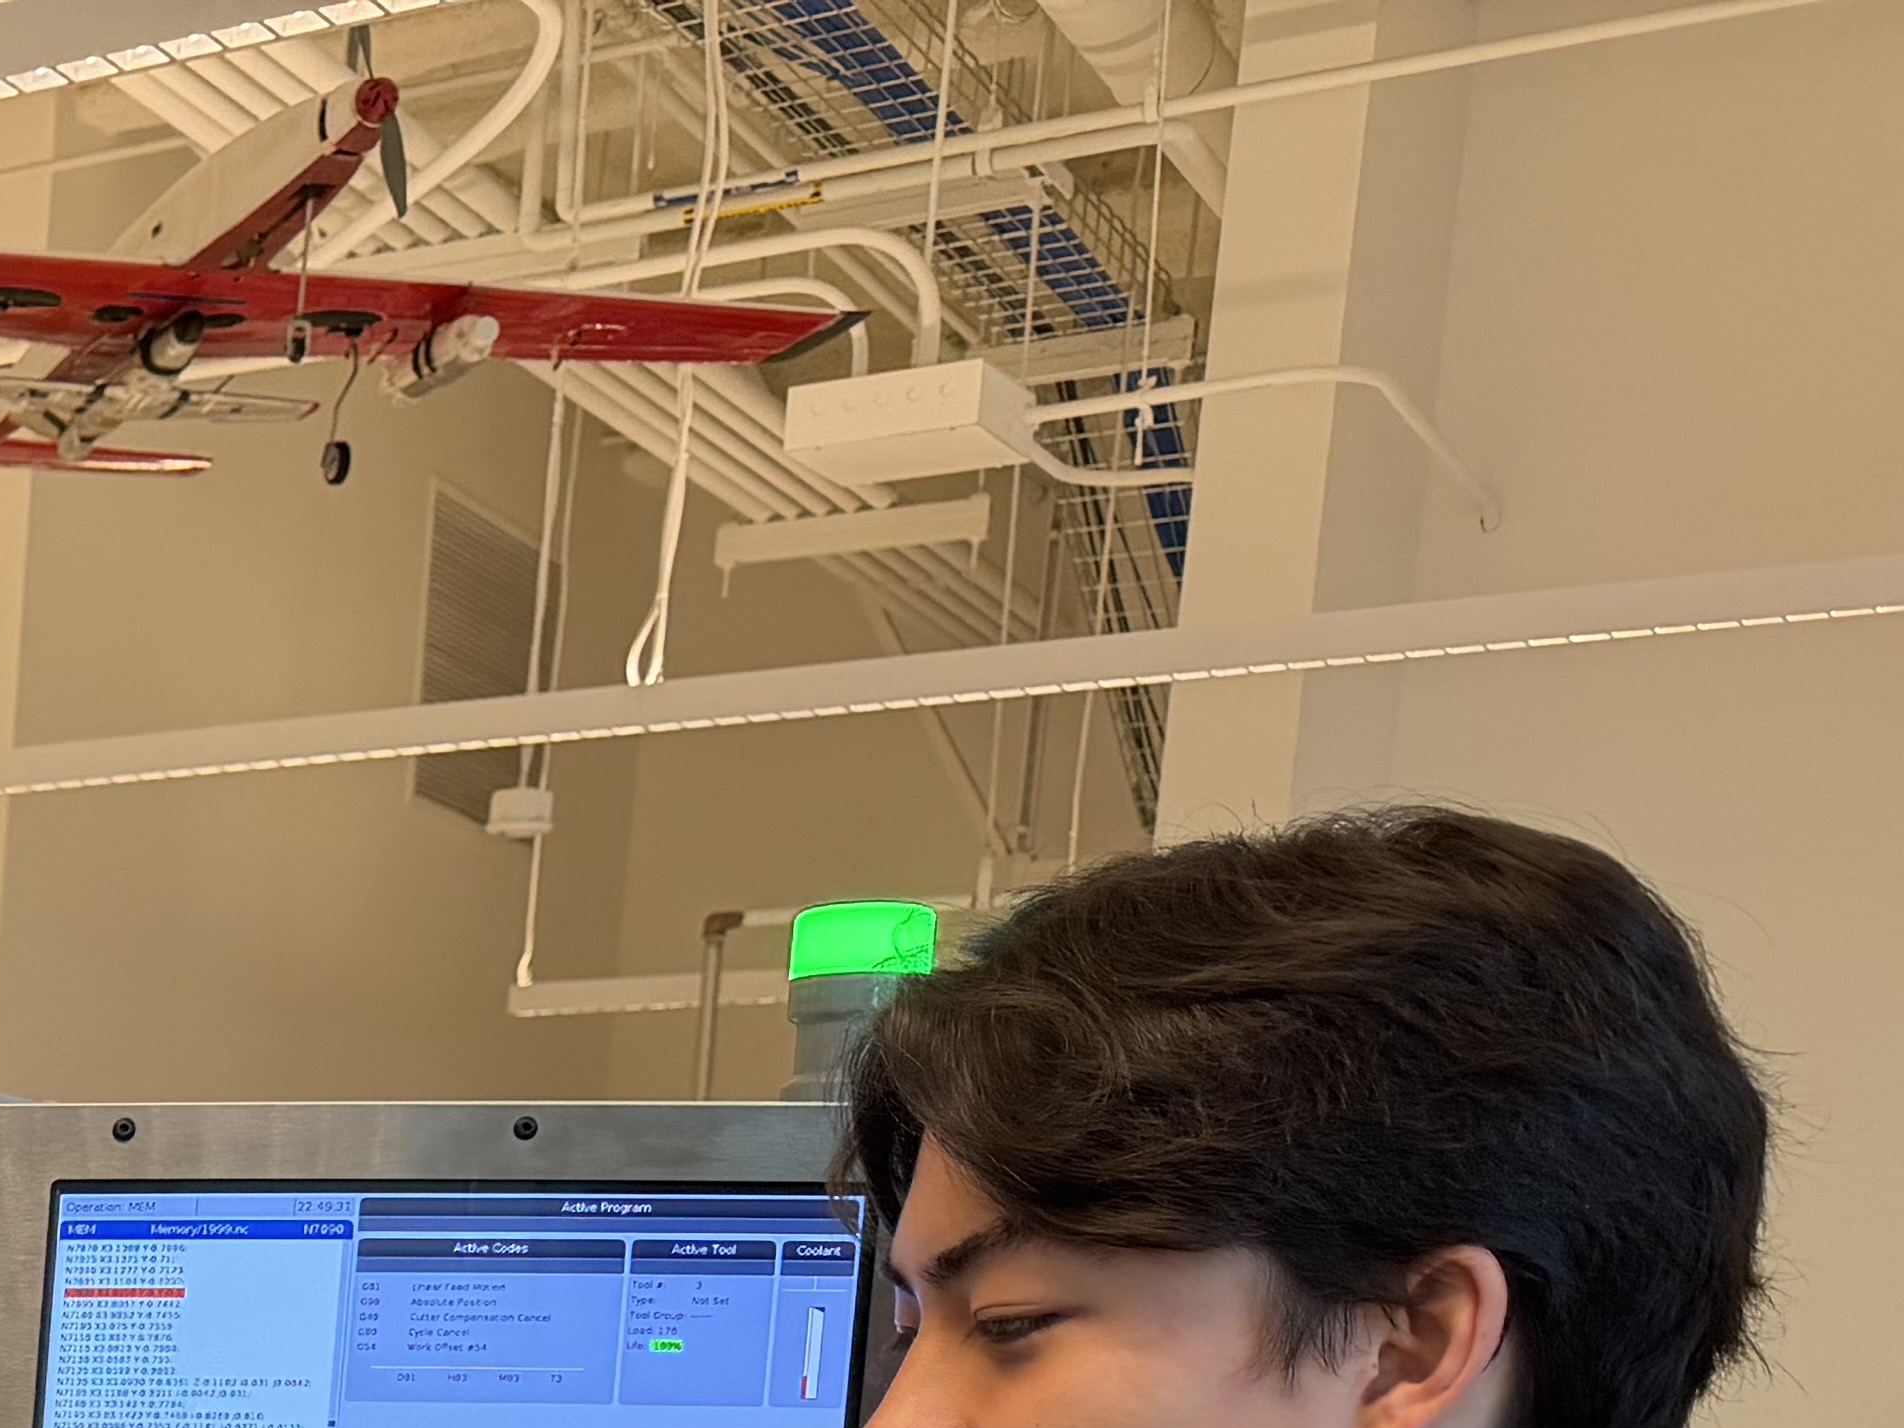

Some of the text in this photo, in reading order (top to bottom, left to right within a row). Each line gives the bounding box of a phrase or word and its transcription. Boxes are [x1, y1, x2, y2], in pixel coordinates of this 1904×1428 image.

[561, 1201, 652, 1215] Active Program
[67, 1225, 97, 1234] MEM
[453, 1242, 529, 1253] Active Codes
[671, 1244, 737, 1255] Active Tool
[796, 1245, 841, 1256] Coolant
